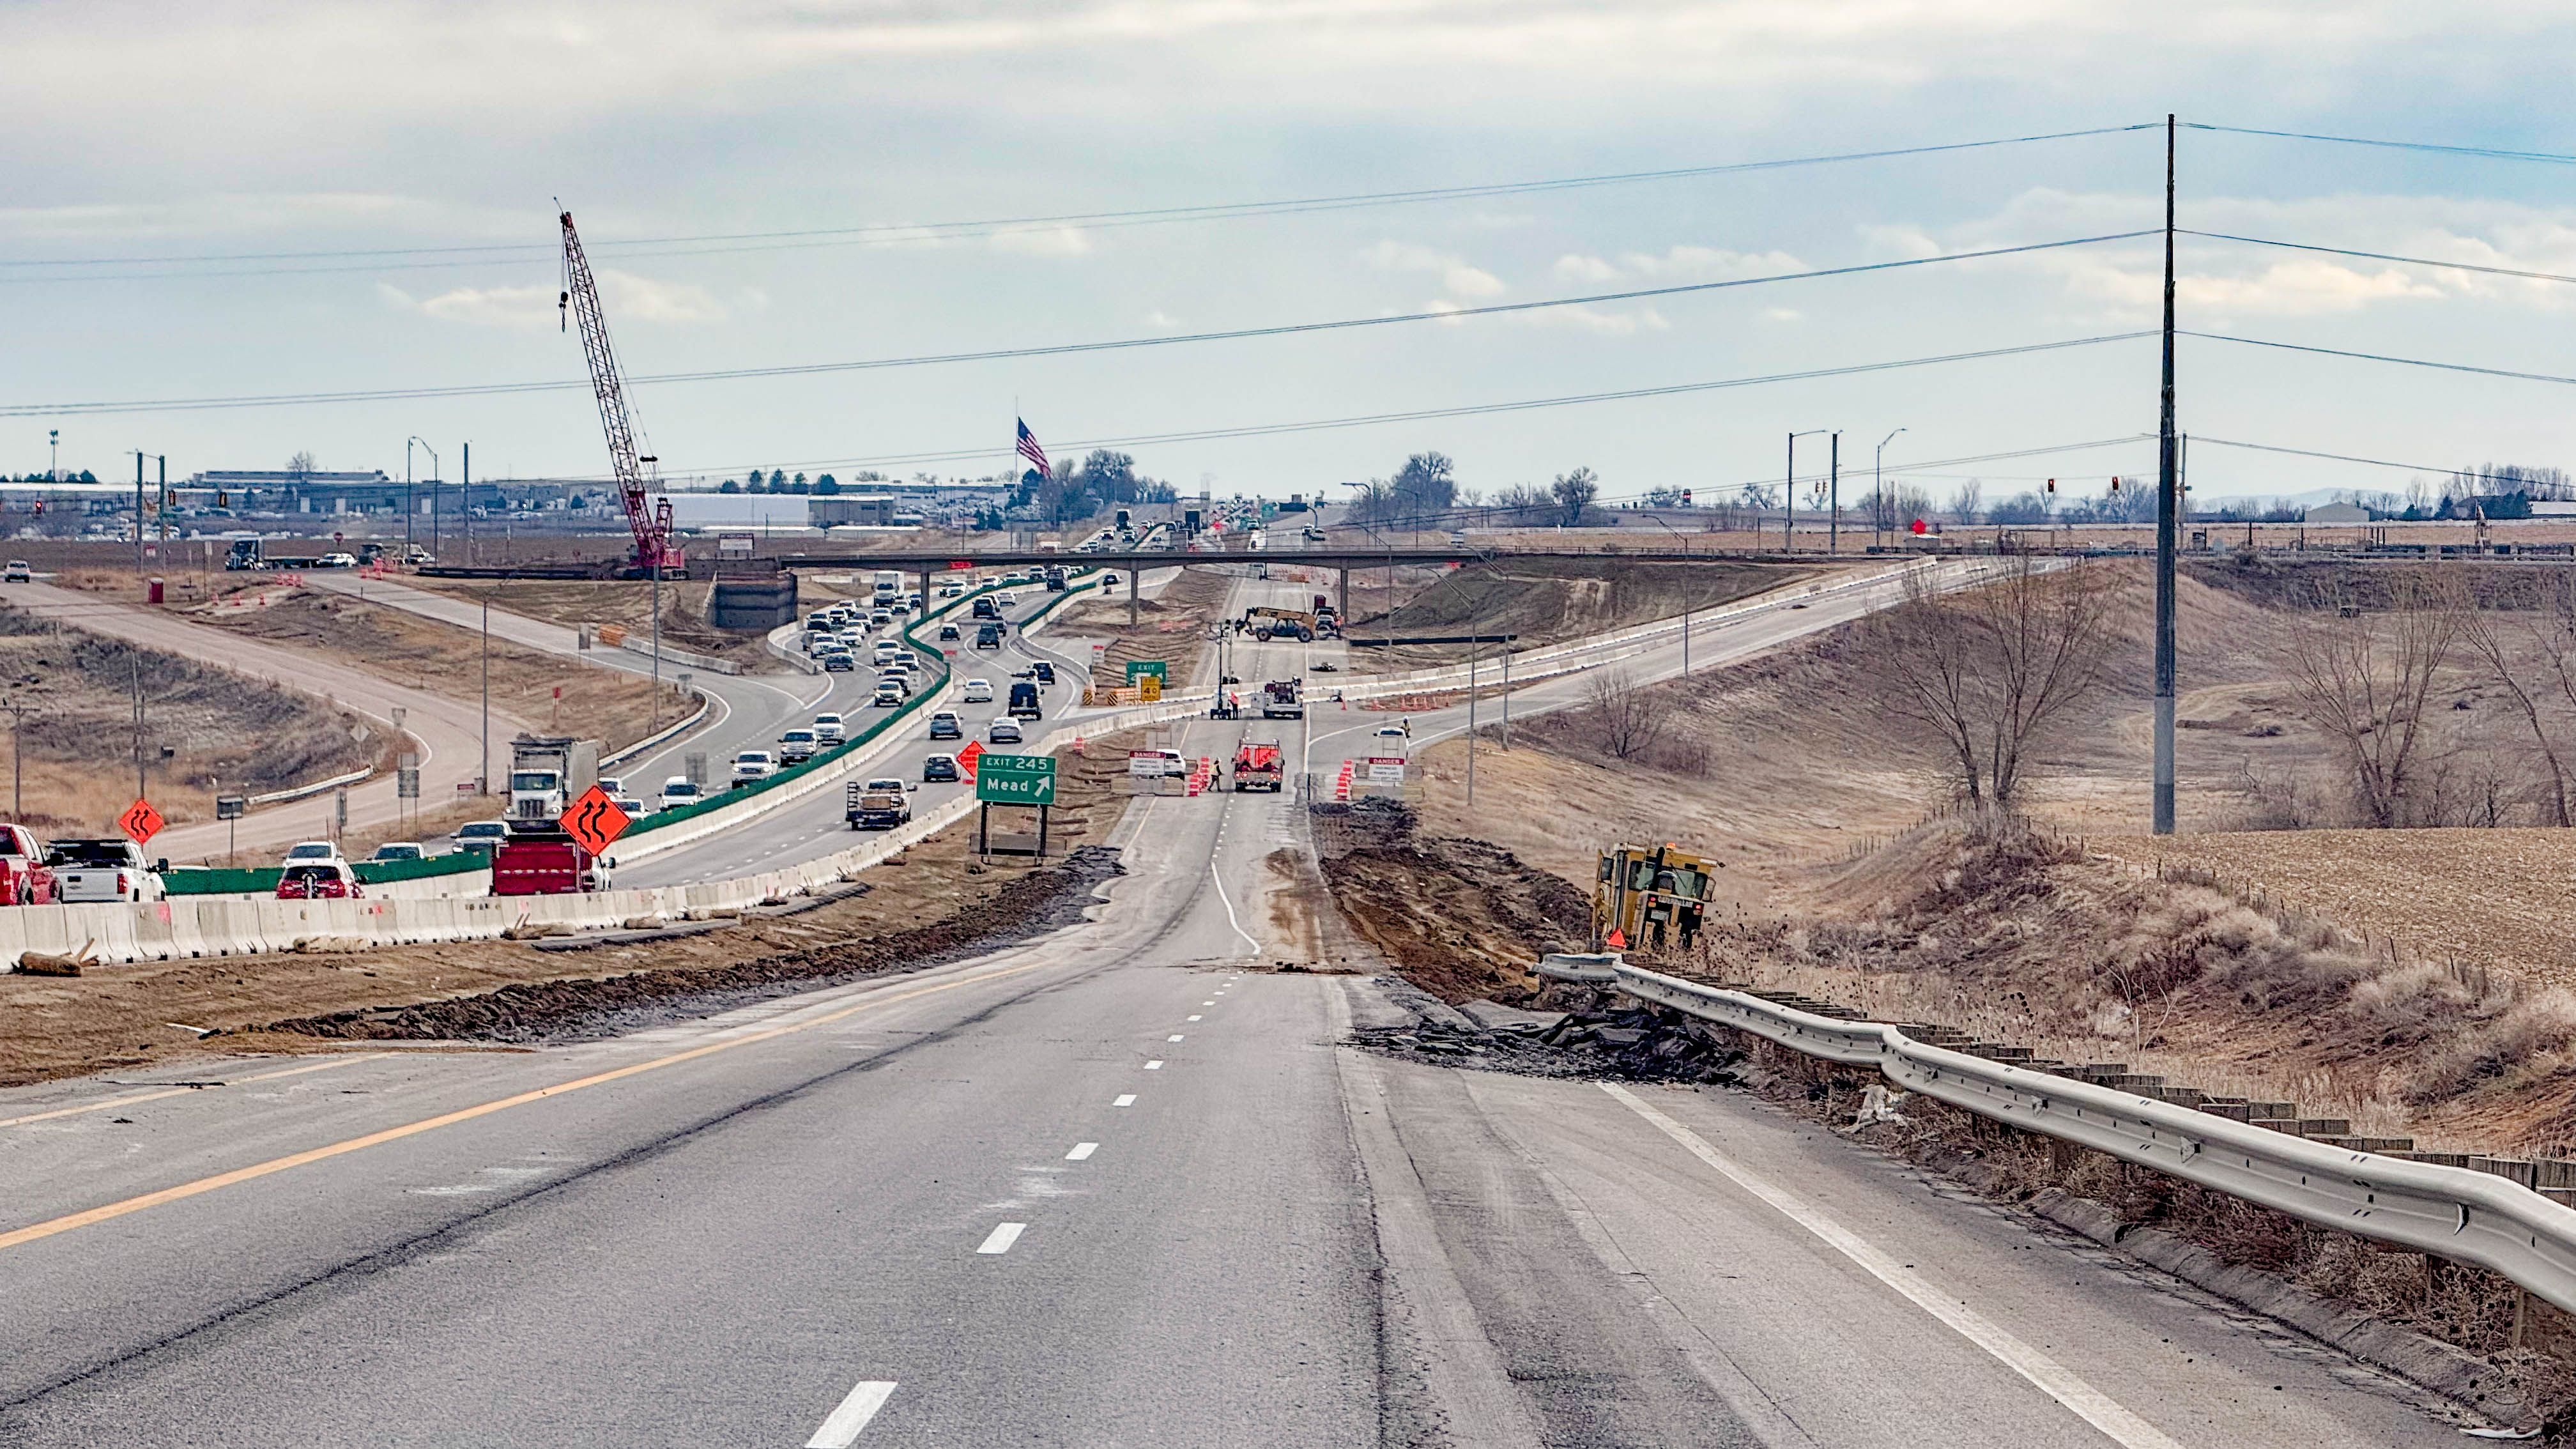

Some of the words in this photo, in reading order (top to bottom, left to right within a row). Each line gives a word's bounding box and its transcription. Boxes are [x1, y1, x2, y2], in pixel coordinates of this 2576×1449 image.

[986, 757, 1009, 766] EXIT
[1016, 758, 1047, 770] 245
[987, 778, 1029, 792] Mead
